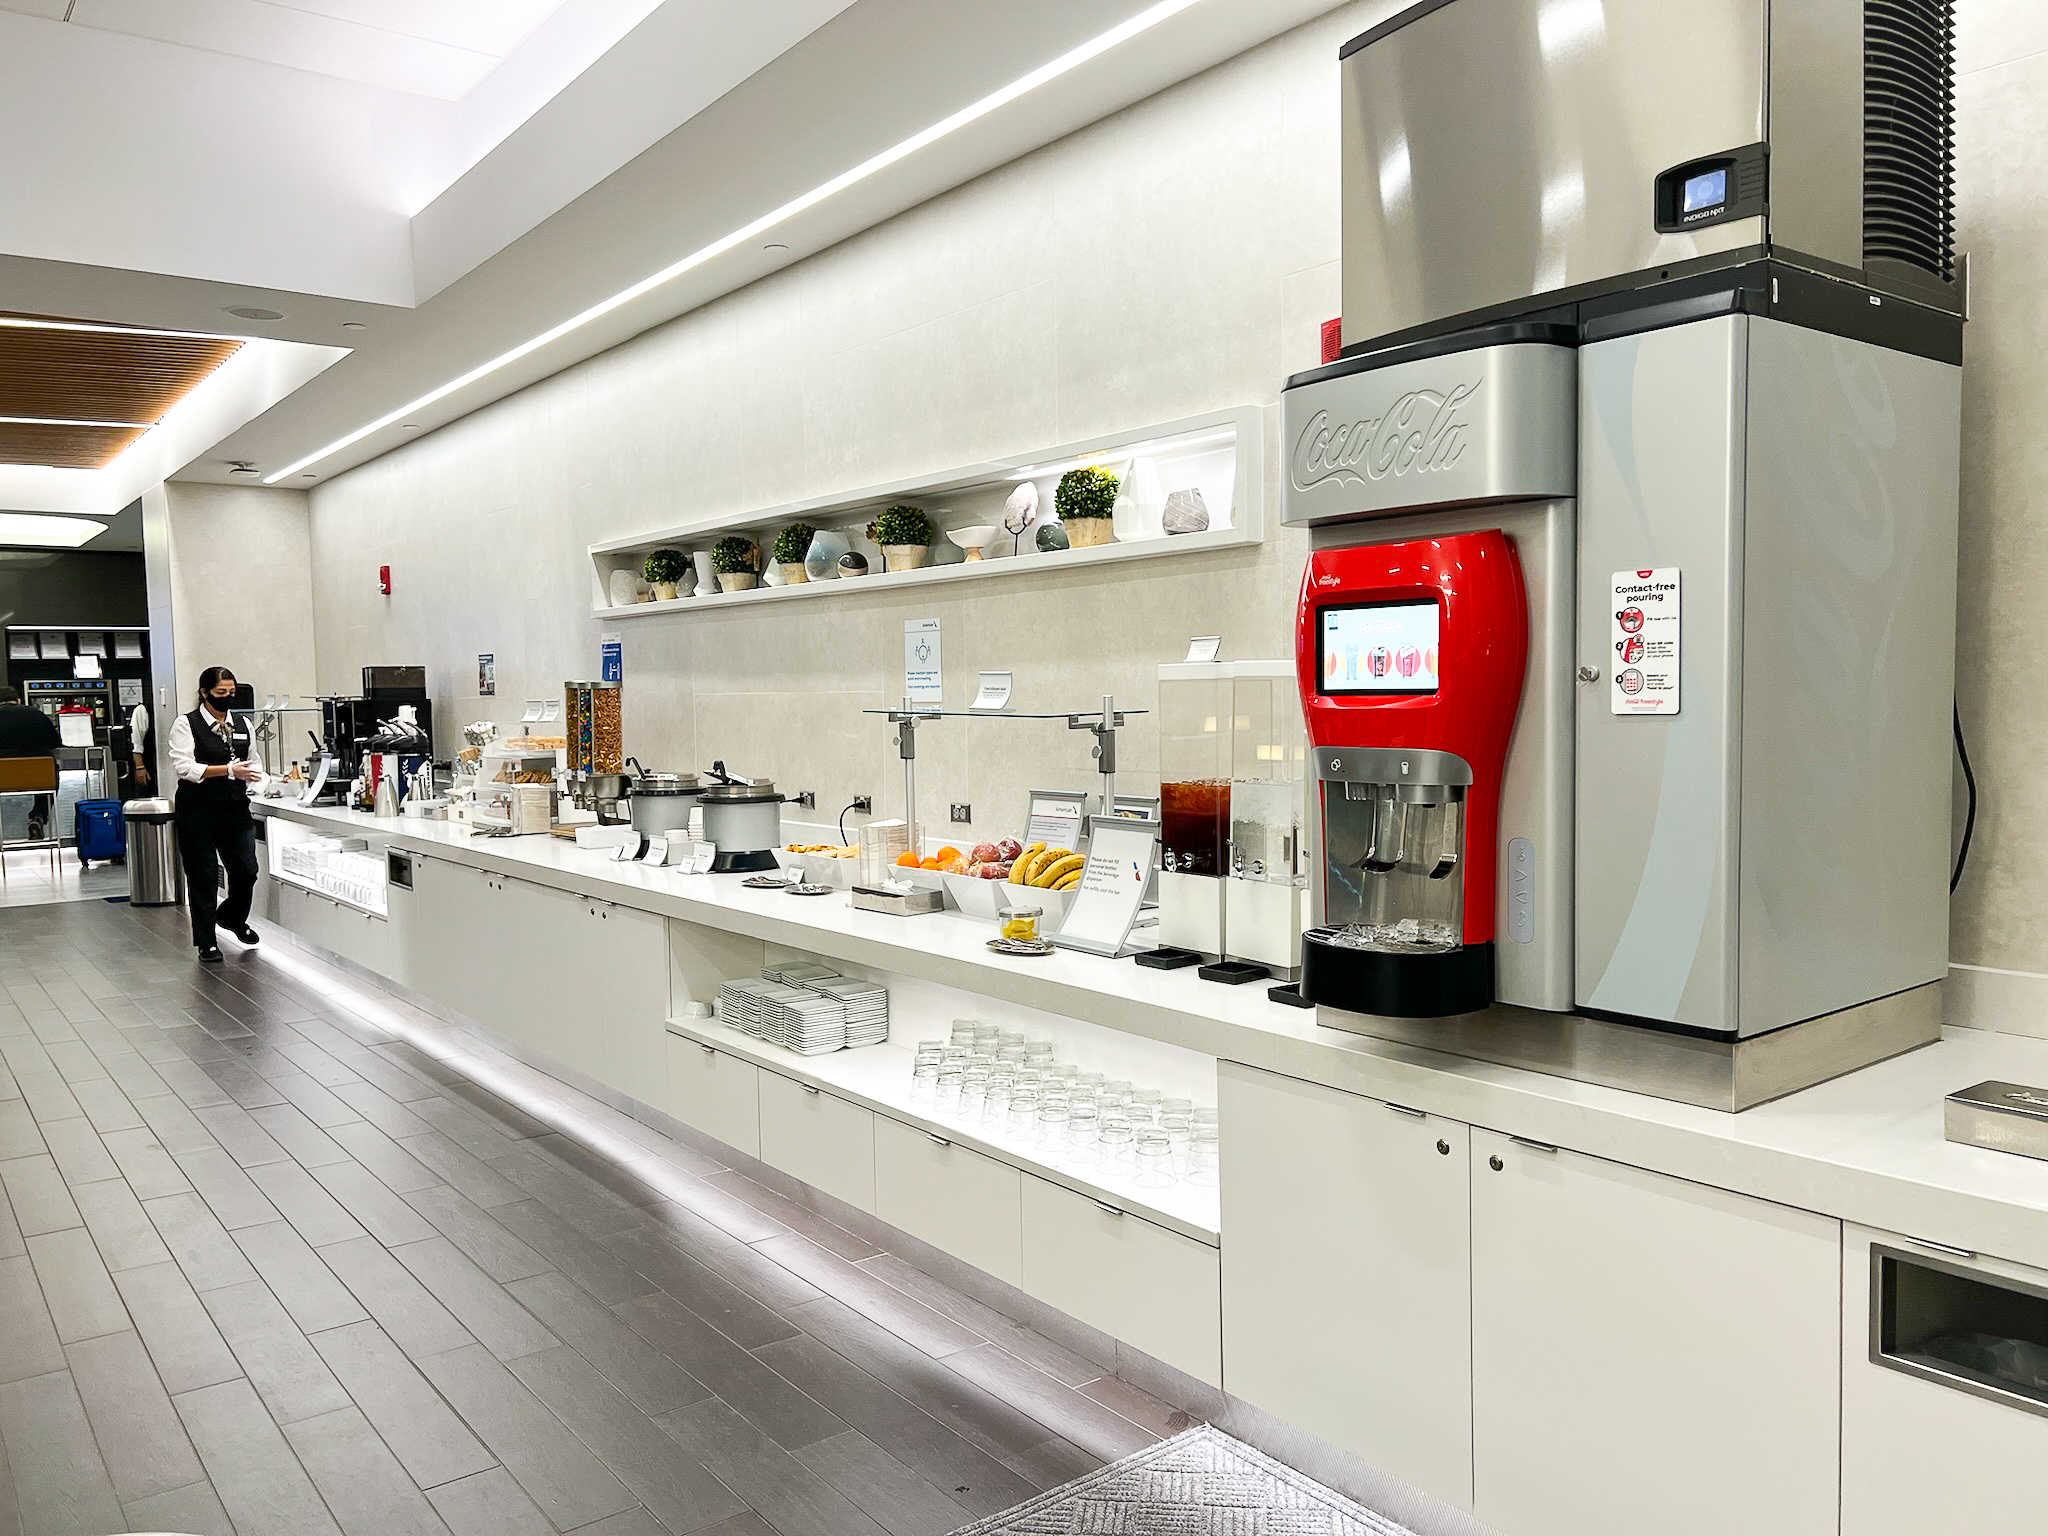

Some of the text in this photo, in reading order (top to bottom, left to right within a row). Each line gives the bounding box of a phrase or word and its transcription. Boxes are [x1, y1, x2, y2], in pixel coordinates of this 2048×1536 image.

[1683, 211, 1710, 223] INDIGO
[1291, 376, 1483, 492] Coca-Cola
[1615, 583, 1676, 594] Contact-free
[1626, 593, 1664, 604] pouring
